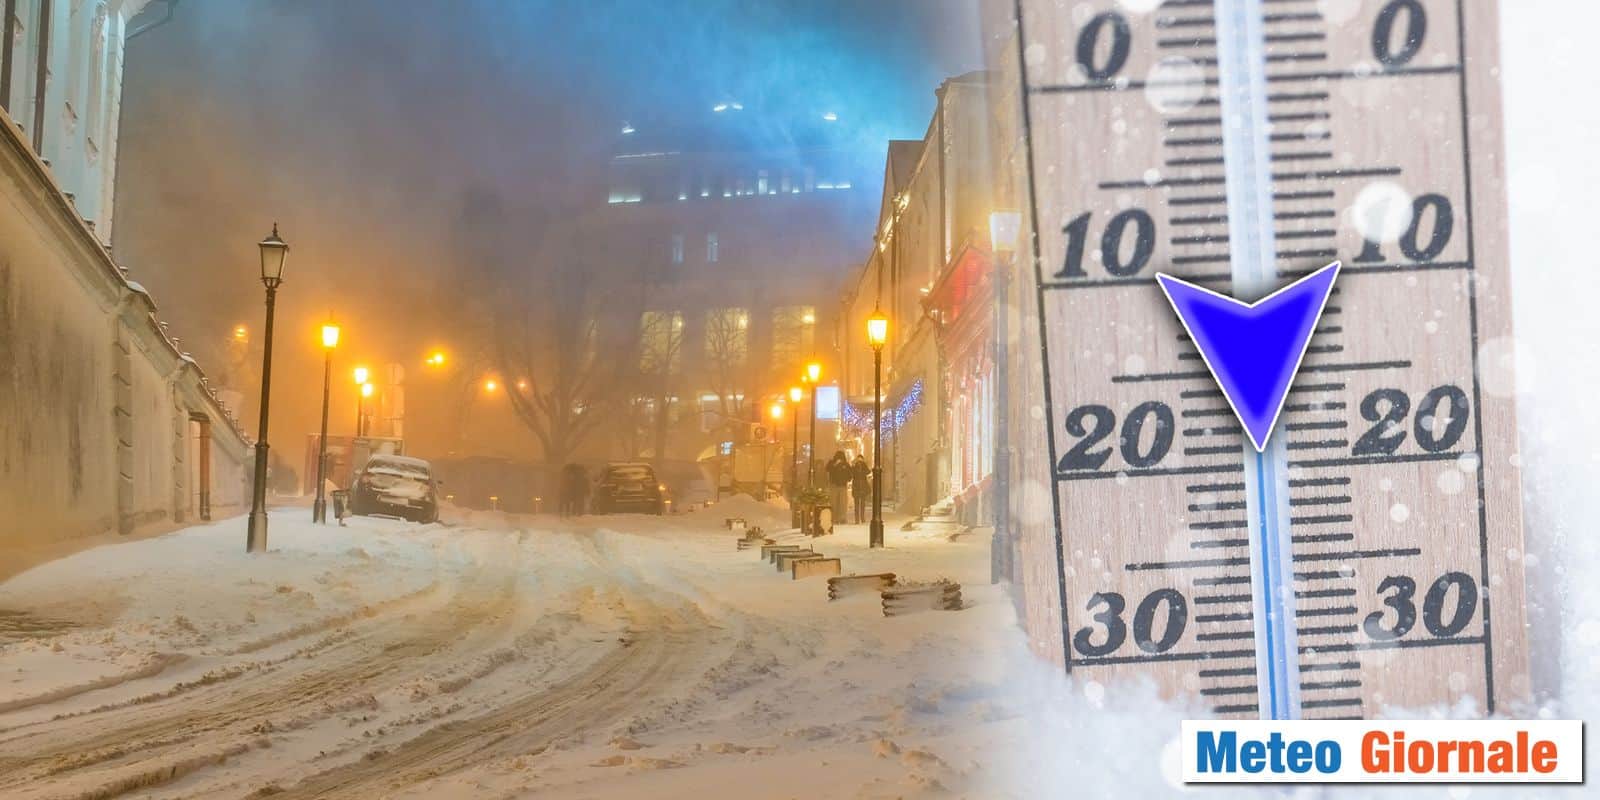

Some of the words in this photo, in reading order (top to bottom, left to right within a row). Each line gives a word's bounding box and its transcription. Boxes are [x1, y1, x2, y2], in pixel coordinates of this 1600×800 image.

[1076, 11, 1132, 83] 0
[1372, 0, 1427, 66] 0
[1054, 208, 1156, 279] 10
[1057, 401, 1176, 472] 20
[1351, 384, 1470, 456] 20
[1073, 587, 1189, 657] 30
[1363, 571, 1479, 641] 30
